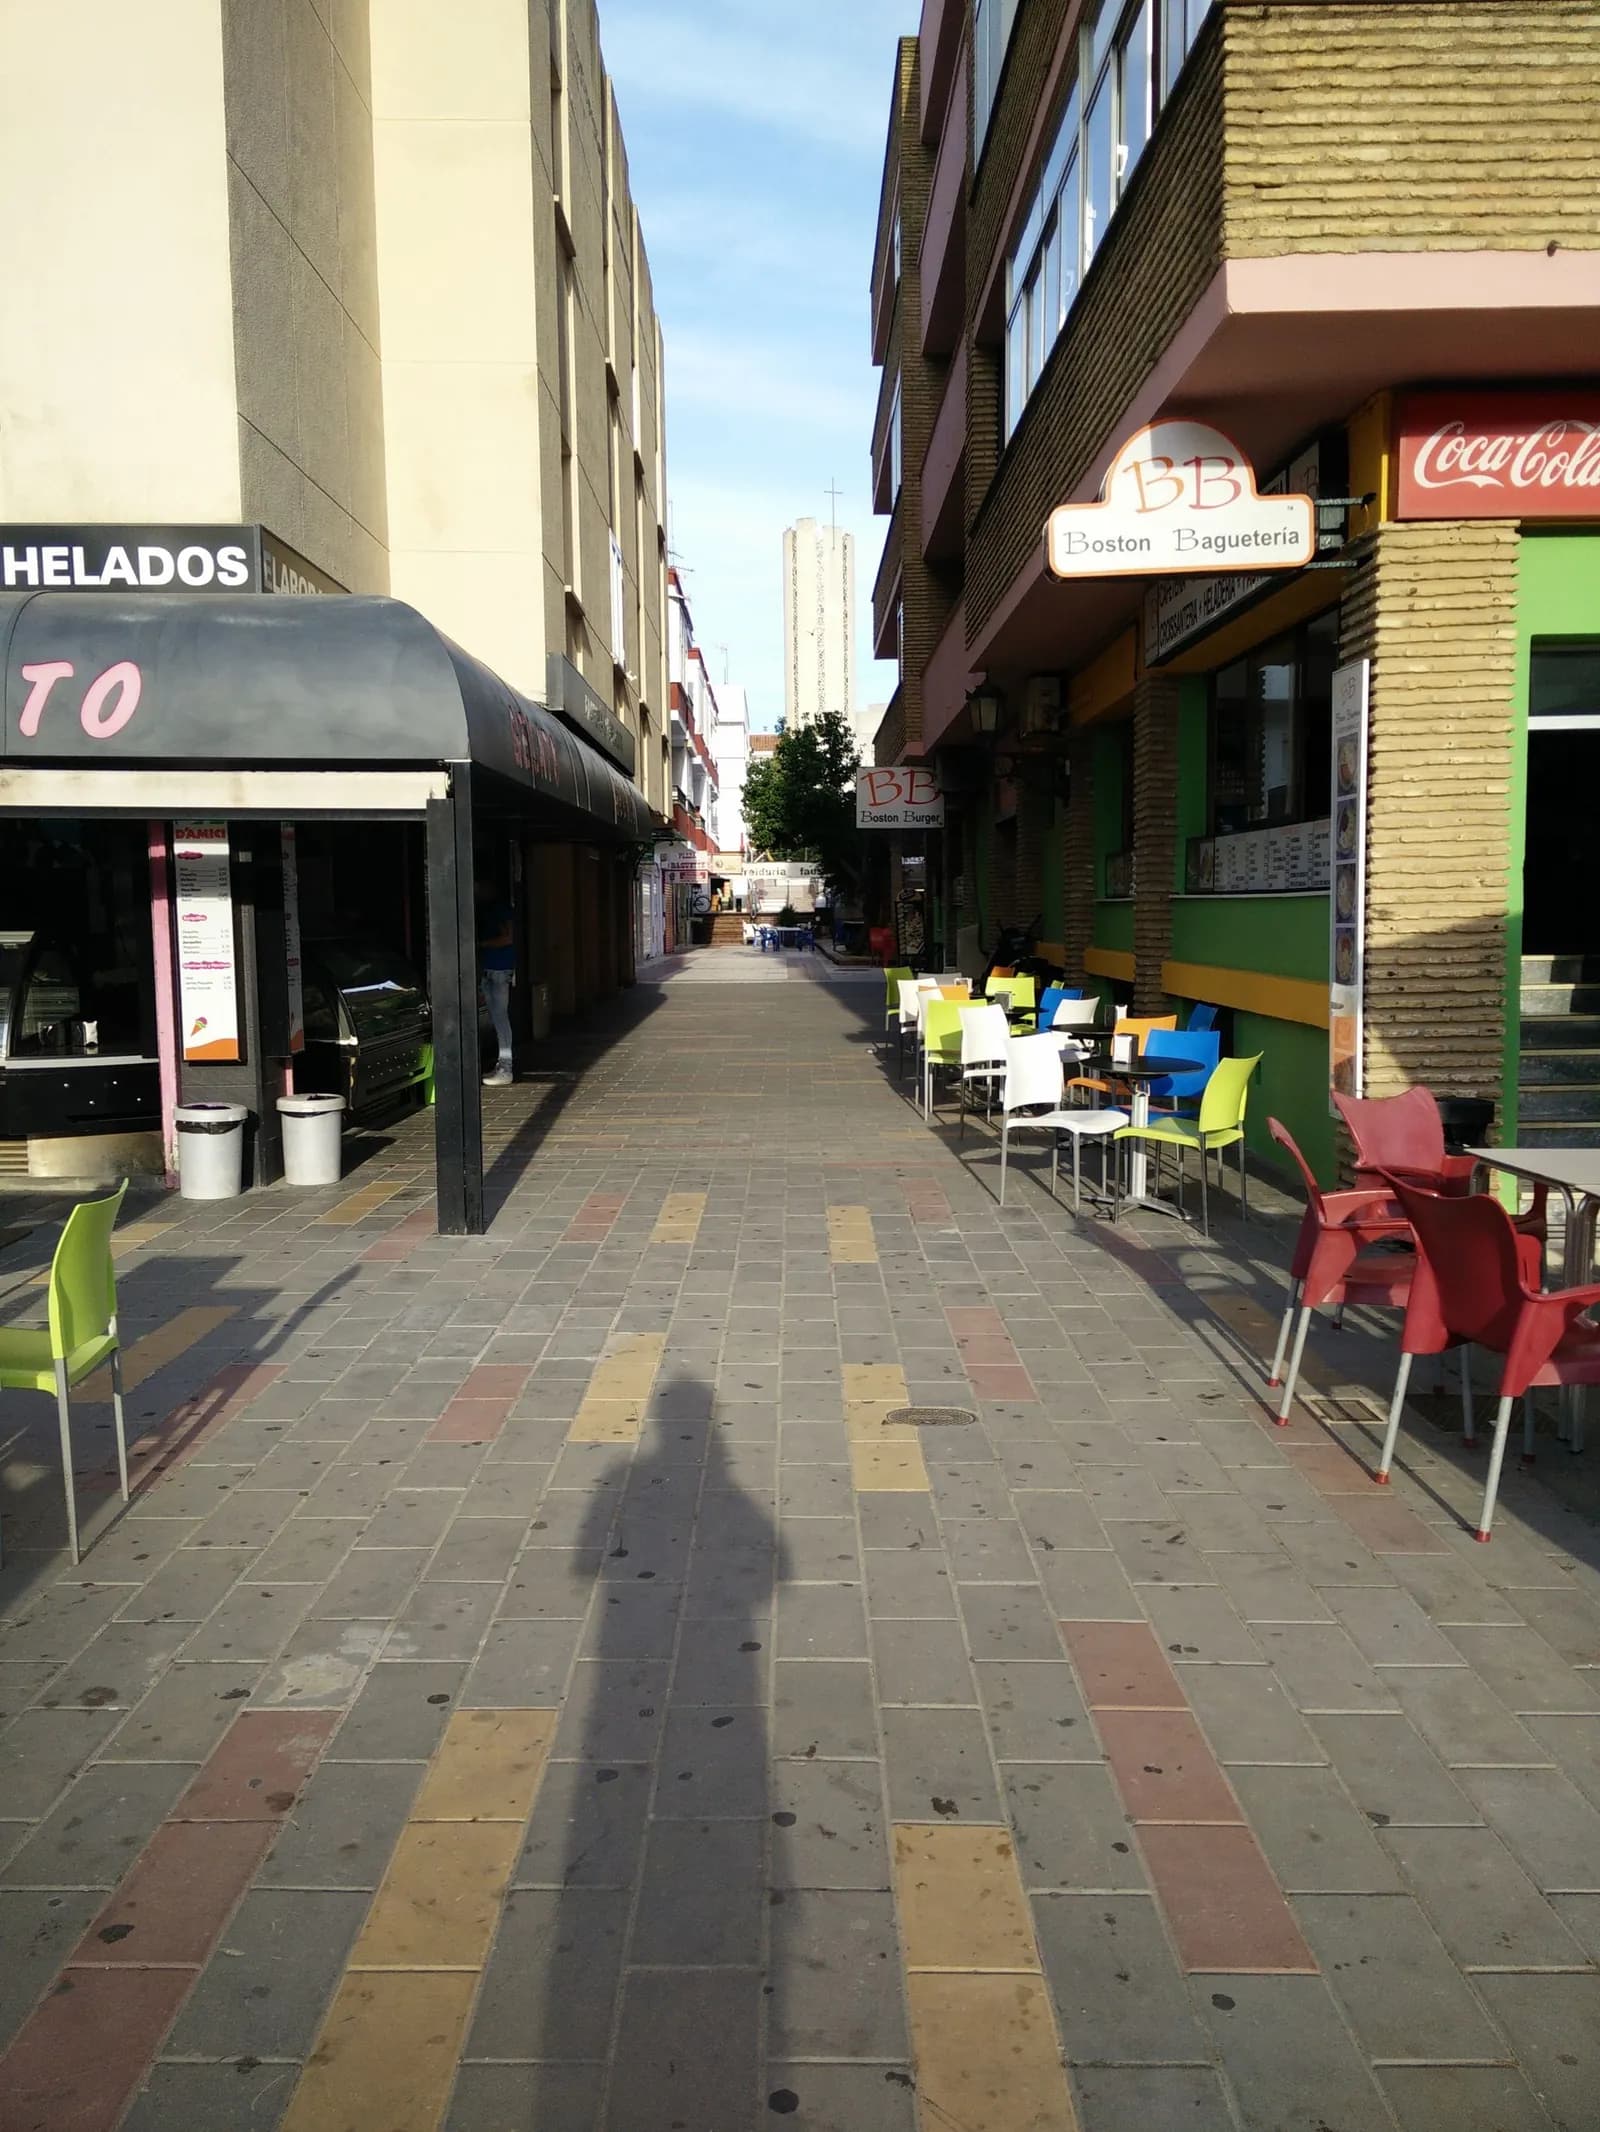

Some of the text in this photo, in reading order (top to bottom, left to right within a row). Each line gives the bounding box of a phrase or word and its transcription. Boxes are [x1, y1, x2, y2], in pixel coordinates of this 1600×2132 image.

[1122, 455, 1242, 514] BB
[1063, 526, 1300, 554] Boston Baguetería
[3, 546, 249, 586] HELADOS
[860, 769, 941, 807] BB
[860, 810, 940, 825] Boston Burger
